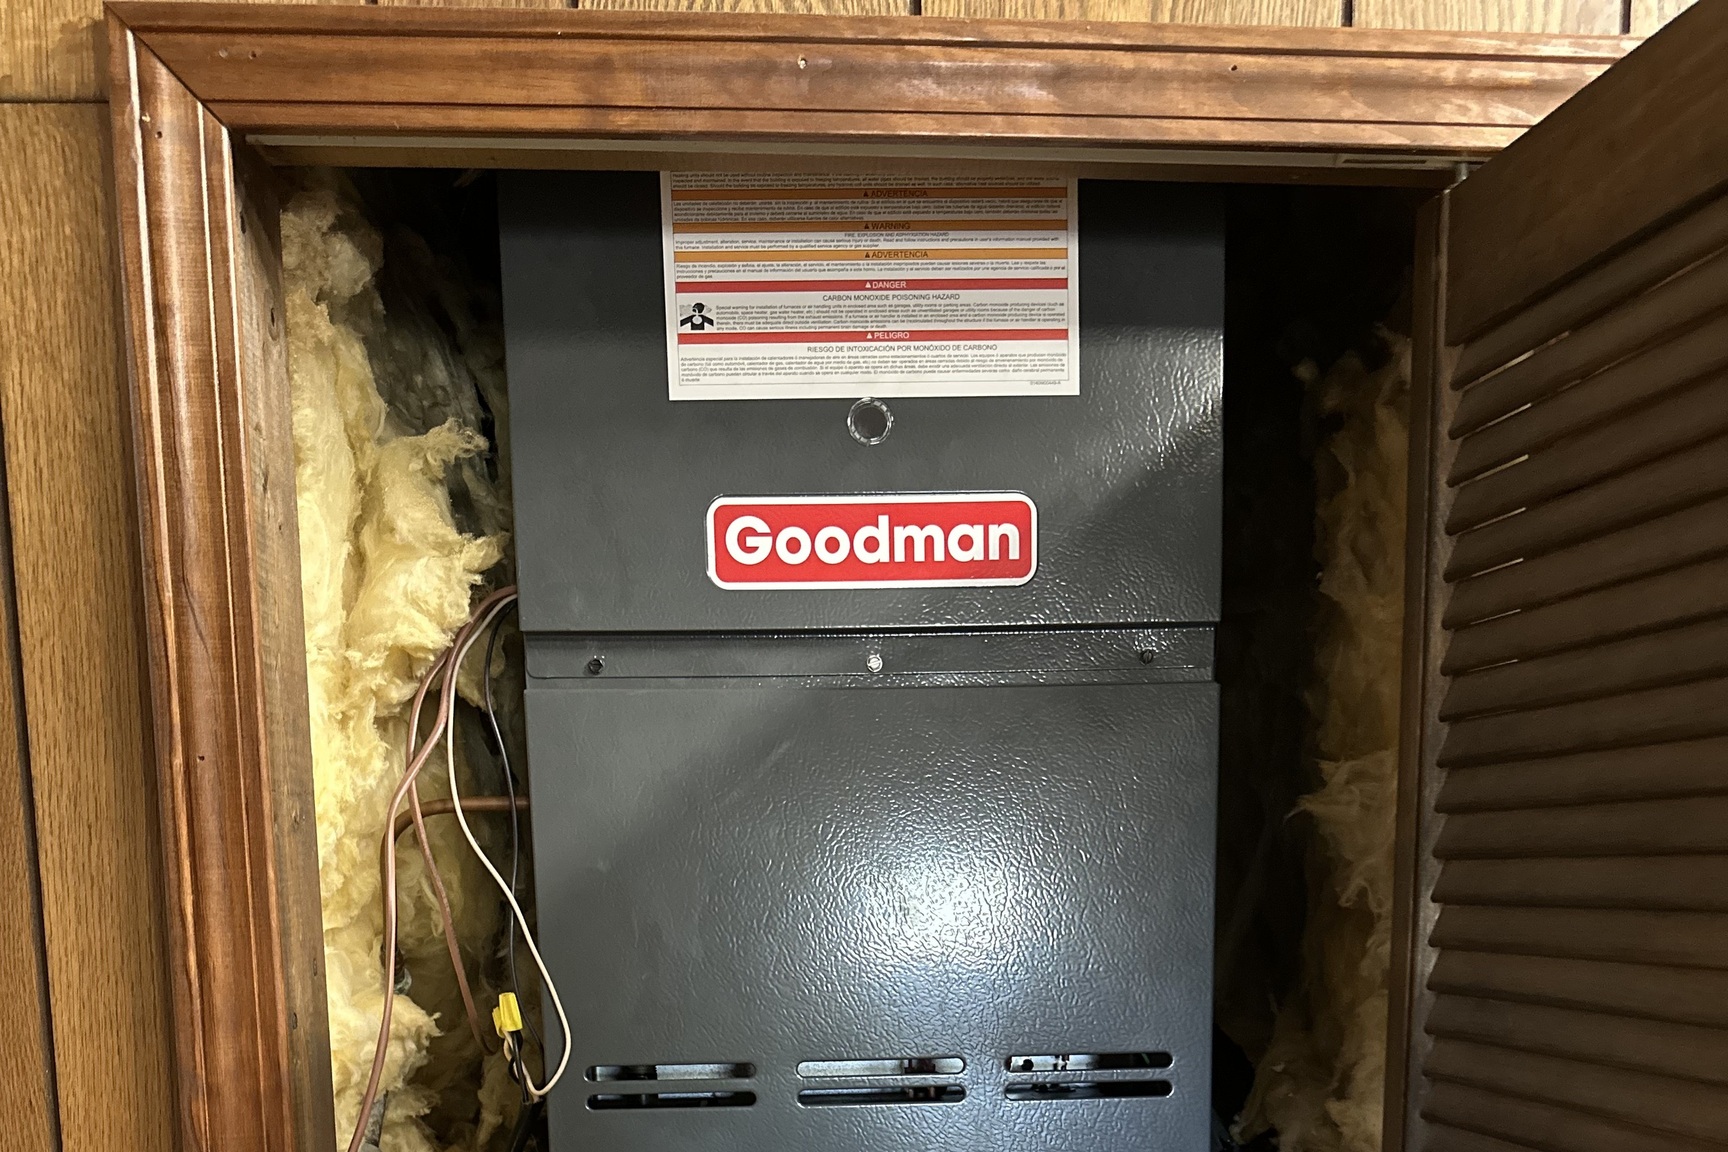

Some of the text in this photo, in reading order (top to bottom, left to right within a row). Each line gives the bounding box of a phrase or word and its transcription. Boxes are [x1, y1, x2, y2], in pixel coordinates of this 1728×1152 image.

[871, 190, 928, 198] ADVERTENCIA
[871, 222, 911, 230] WARNING
[871, 251, 929, 259] ADVERTENCIA
[872, 281, 907, 289] DANGER
[846, 344, 896, 352] INTOXICACIÓN
[913, 343, 951, 352] MONÓXIDO
[725, 515, 1020, 565] Goodman
